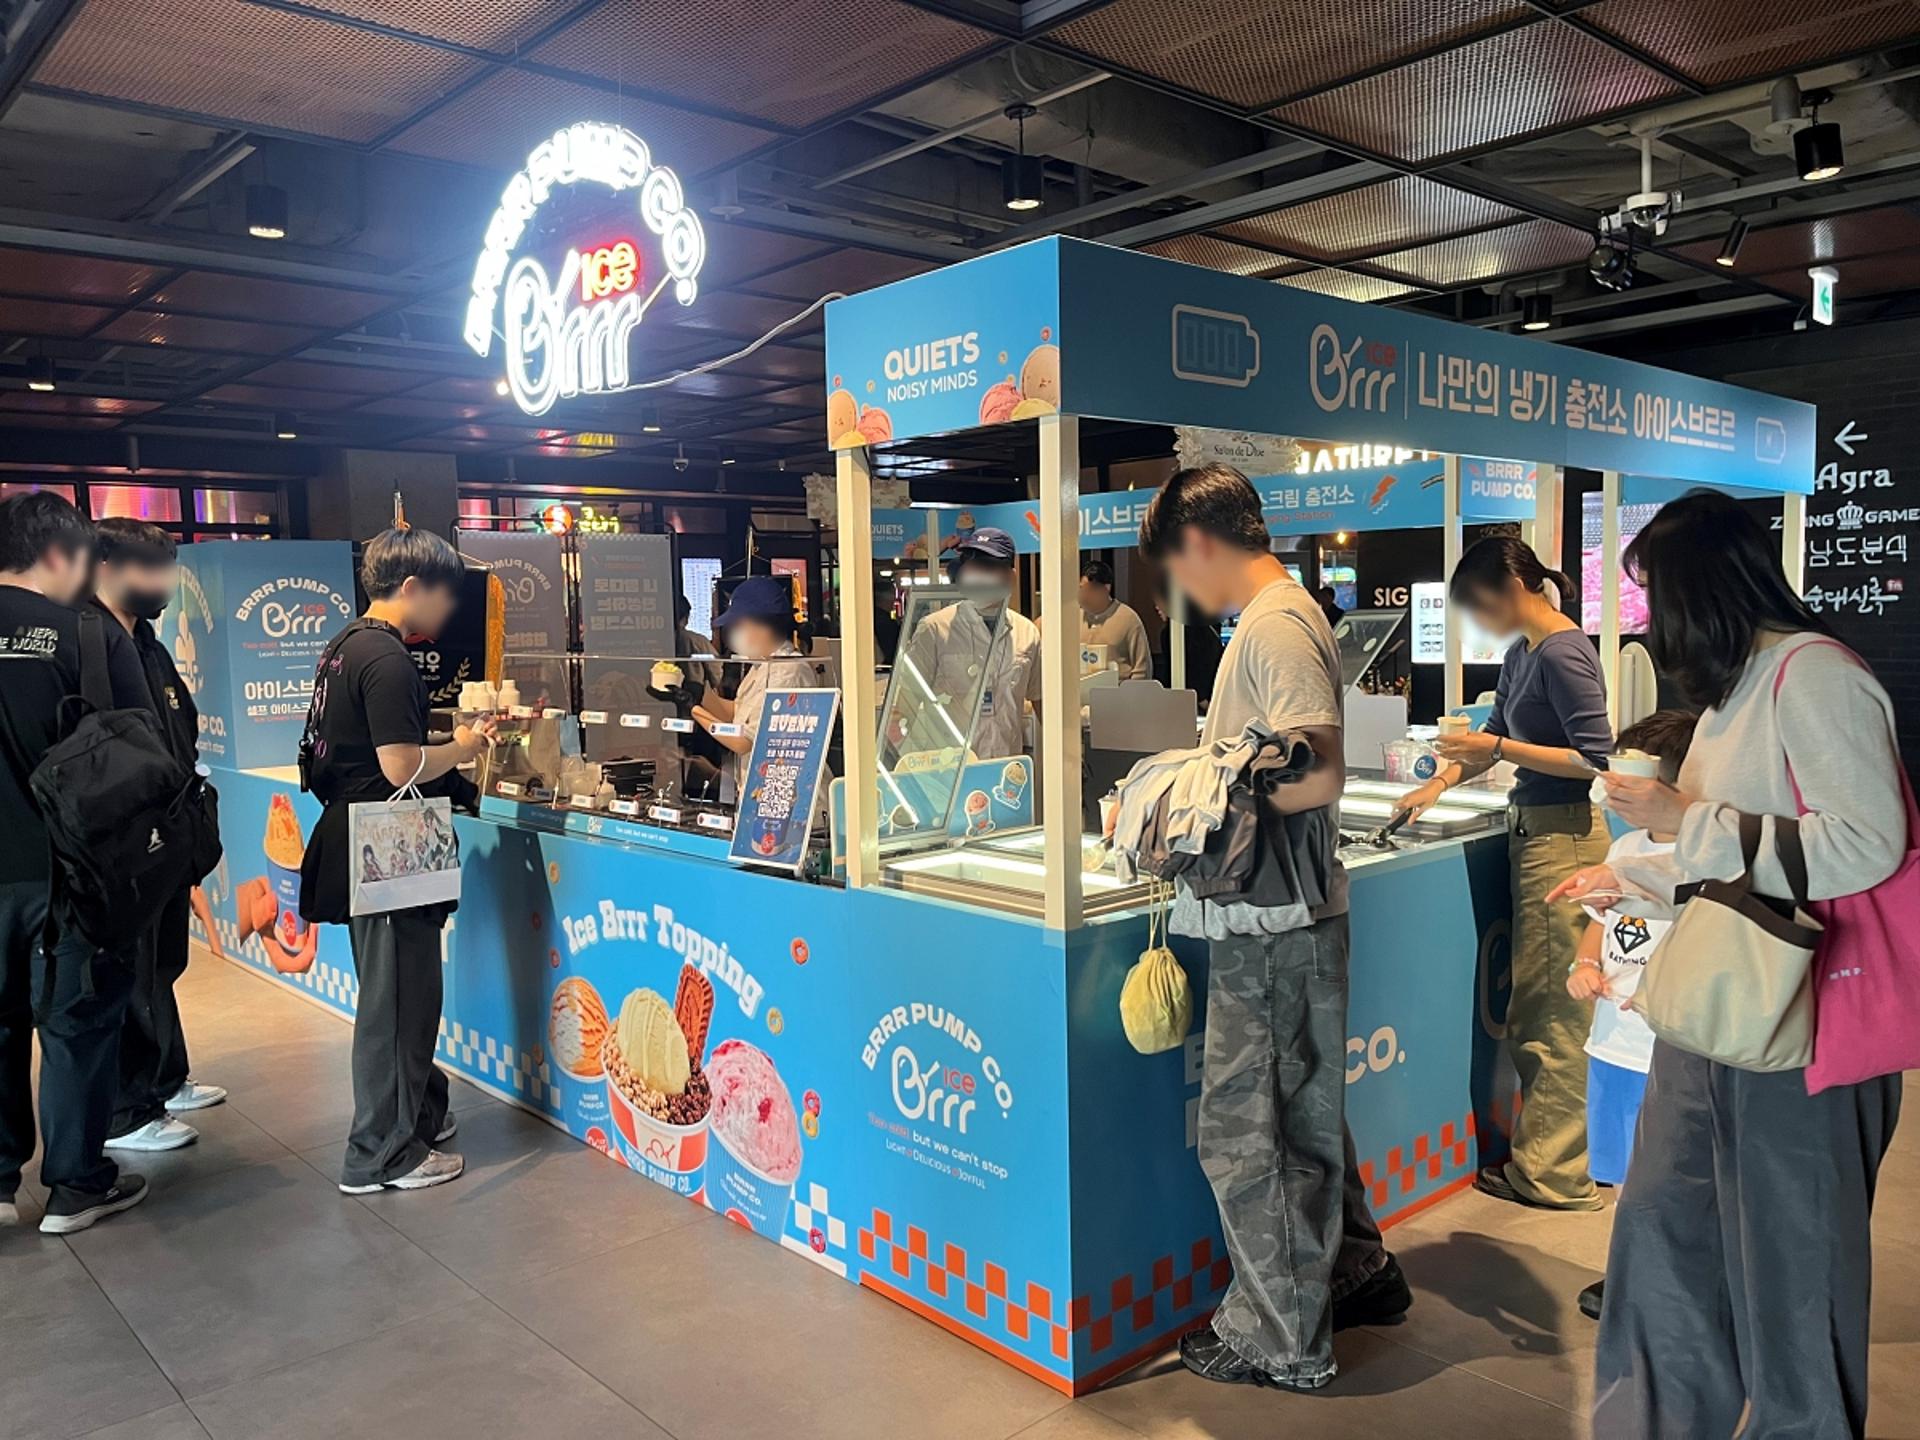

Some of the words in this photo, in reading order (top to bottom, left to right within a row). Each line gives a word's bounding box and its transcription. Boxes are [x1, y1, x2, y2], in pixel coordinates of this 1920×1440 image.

[884, 331, 980, 382] QUIETS
[887, 378, 928, 403] NOISY
[930, 369, 979, 395] MINDS
[1418, 351, 1500, 417] 나만의
[1509, 367, 1557, 426] 냉기
[1564, 378, 1628, 436] 충전소
[1633, 390, 1736, 452] 아이스브르르
[1485, 462, 1524, 480] BRRR
[1815, 462, 1895, 494] Agra
[1305, 483, 1355, 507] 충전소
[1471, 480, 1512, 498] PUMP
[1513, 482, 1537, 501] CO.
[1864, 508, 1920, 523] GAME
[1808, 534, 1907, 568] 남도분식
[235, 582, 276, 622] BRRR
[276, 577, 330, 595] PUMP
[329, 592, 352, 619] CO.
[1374, 586, 1409, 607] SIG
[768, 714, 819, 734] EVENT
[562, 913, 600, 956] Ice
[598, 899, 649, 942] Brrr
[653, 903, 766, 1019] Topping
[861, 1005, 910, 1071] BRRR
[910, 1002, 982, 1053] PUMP
[982, 1055, 1013, 1119] CO.
[912, 1129, 931, 1148] but
[932, 1141, 950, 1155] we
[951, 1148, 979, 1167] can't
[981, 1160, 1008, 1180] stop
